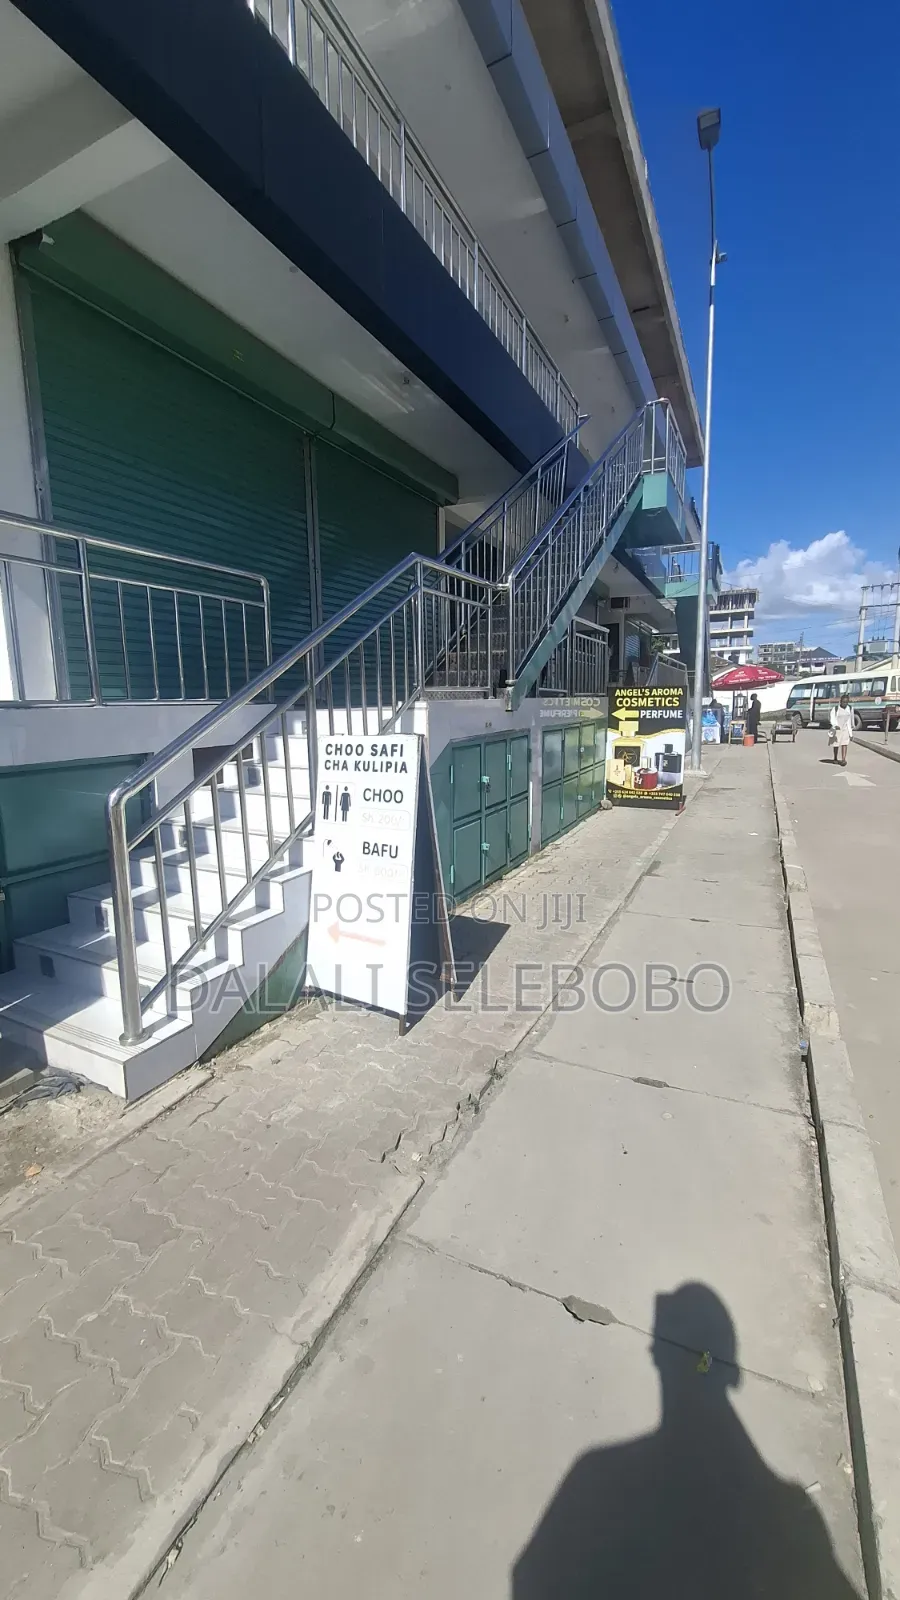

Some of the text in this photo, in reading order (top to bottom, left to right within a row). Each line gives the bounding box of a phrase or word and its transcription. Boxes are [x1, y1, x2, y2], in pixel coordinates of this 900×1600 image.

[614, 687, 684, 697] ANGEL'S AROMA
[615, 696, 681, 708] COSMETICS
[640, 709, 684, 719] PERFUME
[325, 743, 404, 758] CHOO SAFI
[324, 759, 408, 774] CHA KULIPIA
[363, 787, 404, 804] CHOO
[362, 841, 399, 859] BAFU
